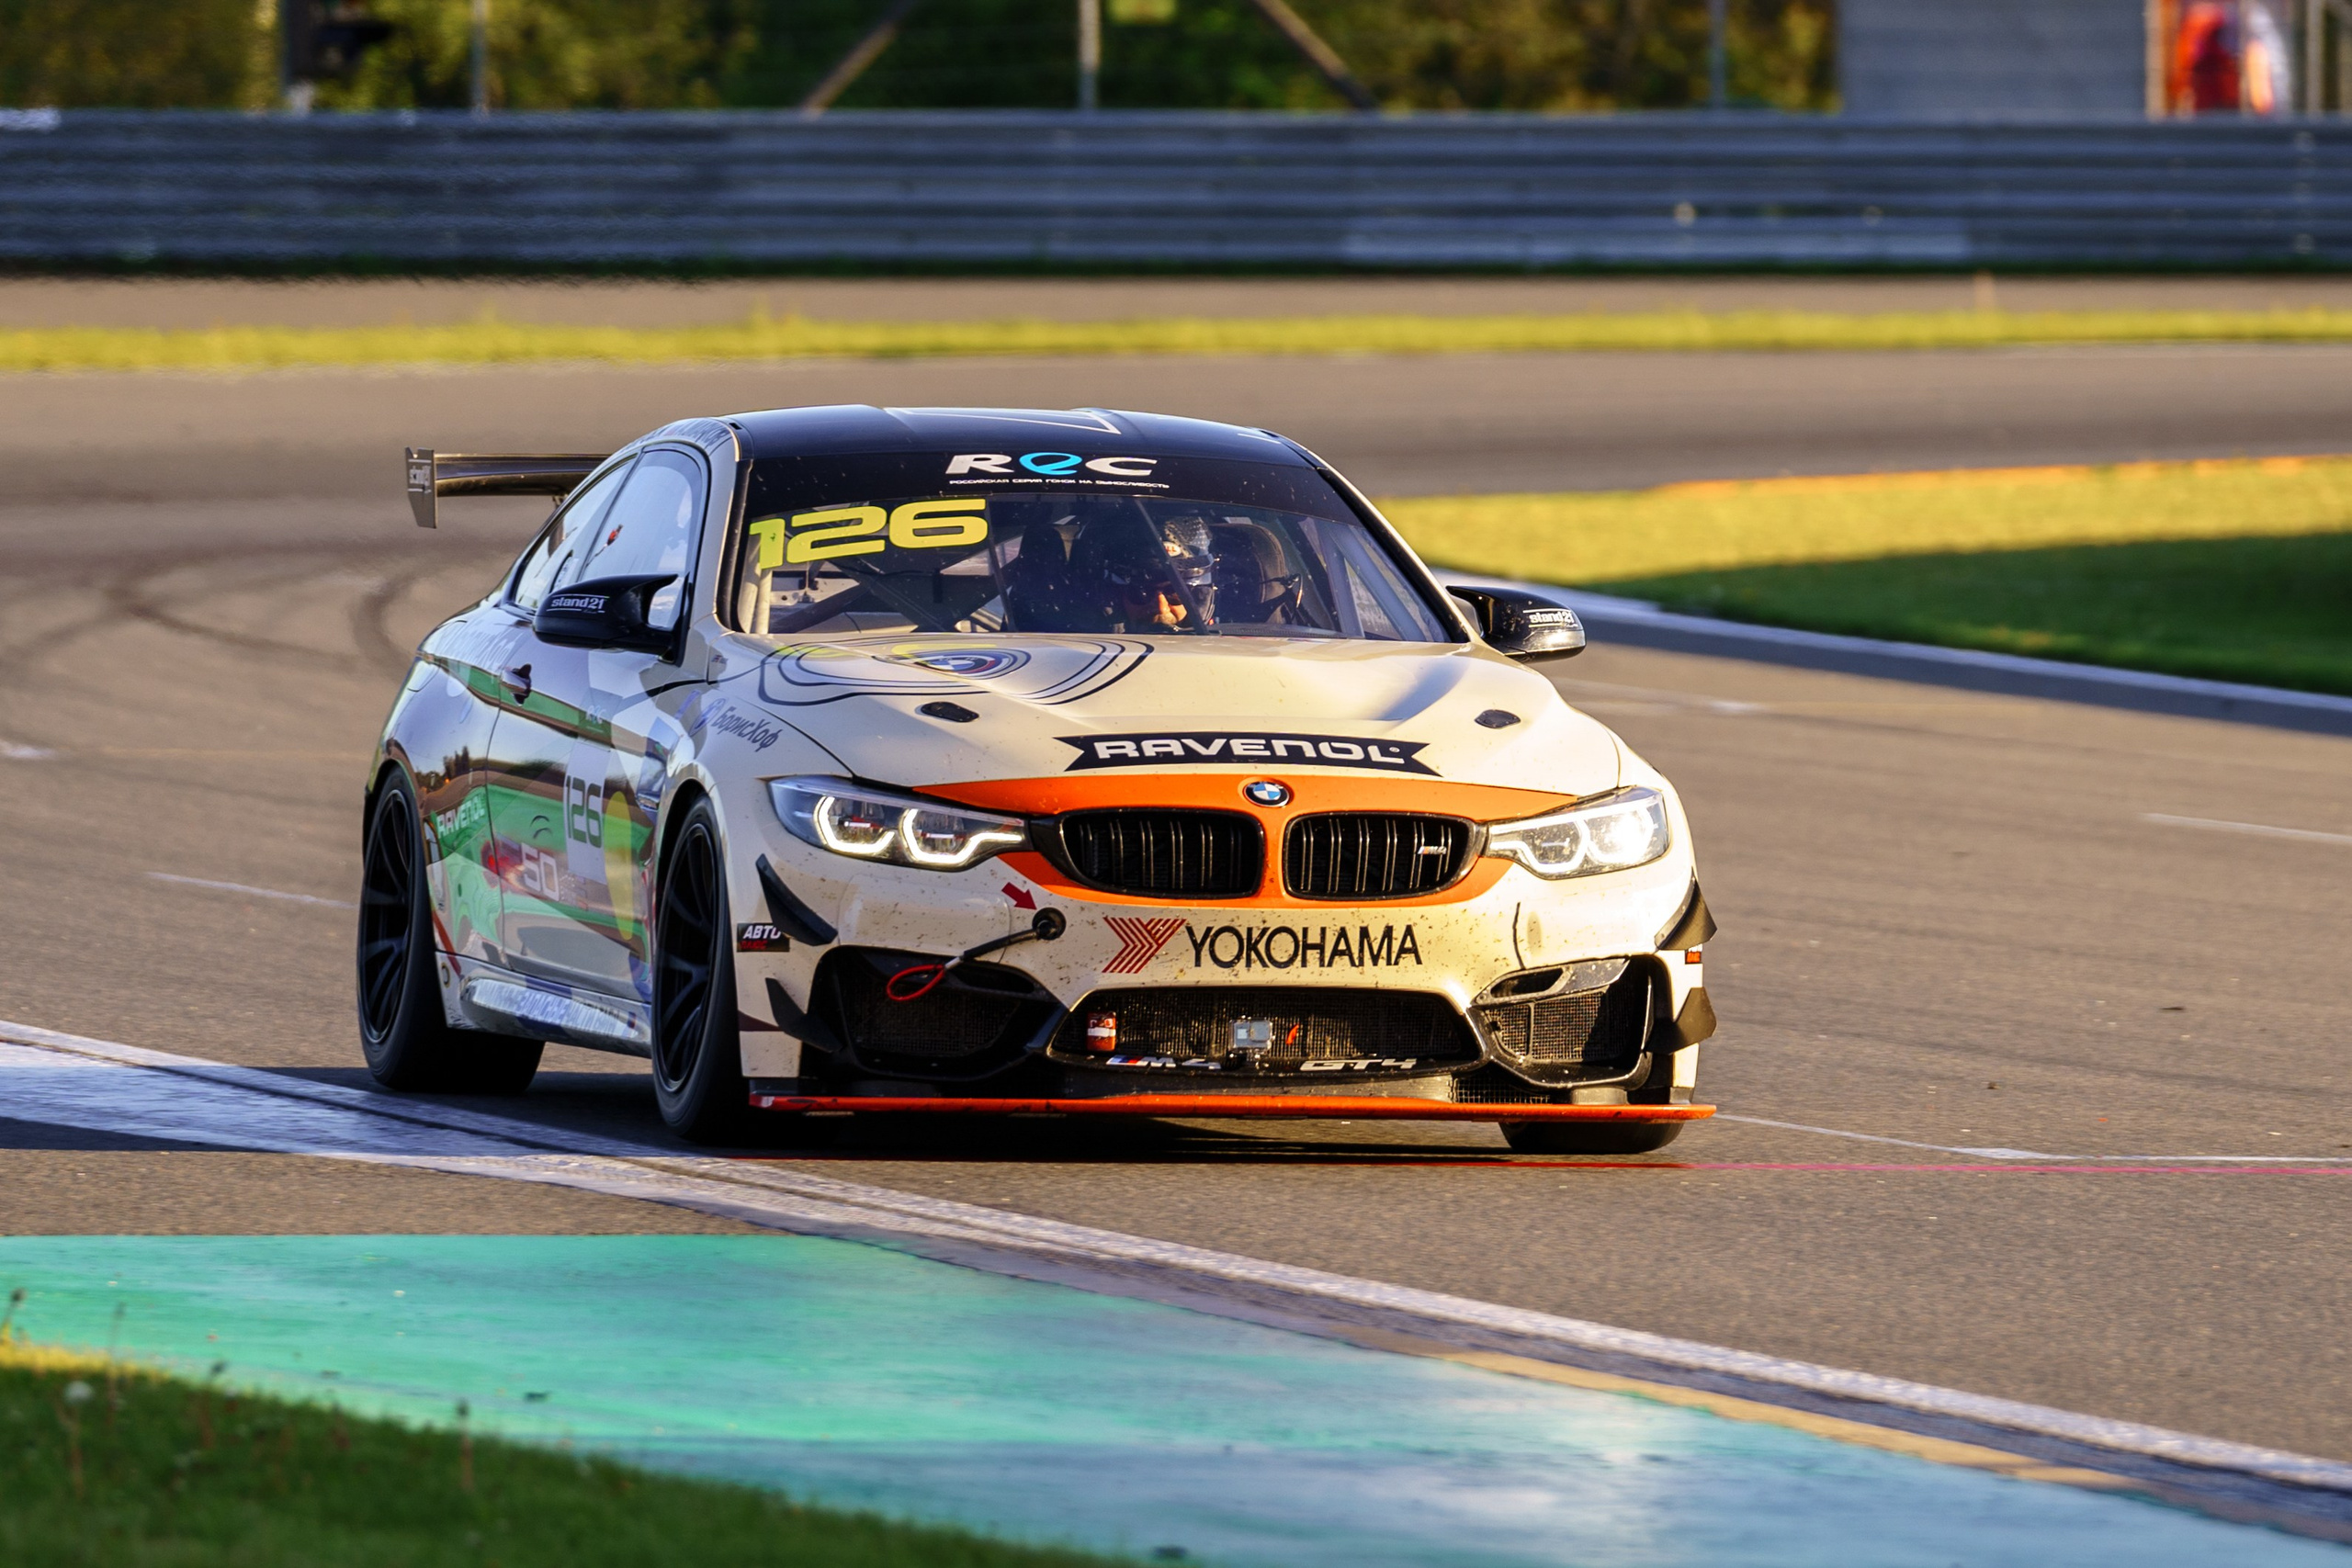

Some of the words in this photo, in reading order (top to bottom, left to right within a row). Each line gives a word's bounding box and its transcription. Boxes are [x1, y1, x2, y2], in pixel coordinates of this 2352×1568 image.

[749, 498, 989, 570] 126
[551, 597, 605, 610] stand21
[1529, 611, 1575, 624] stand21
[711, 705, 783, 752] БорисХоф
[1093, 739, 1406, 765] RAVENOL
[565, 774, 603, 849] 126
[521, 841, 560, 902] 50
[1186, 923, 1423, 969] YOKOHAMA
[1299, 1058, 1418, 1071] GT4
